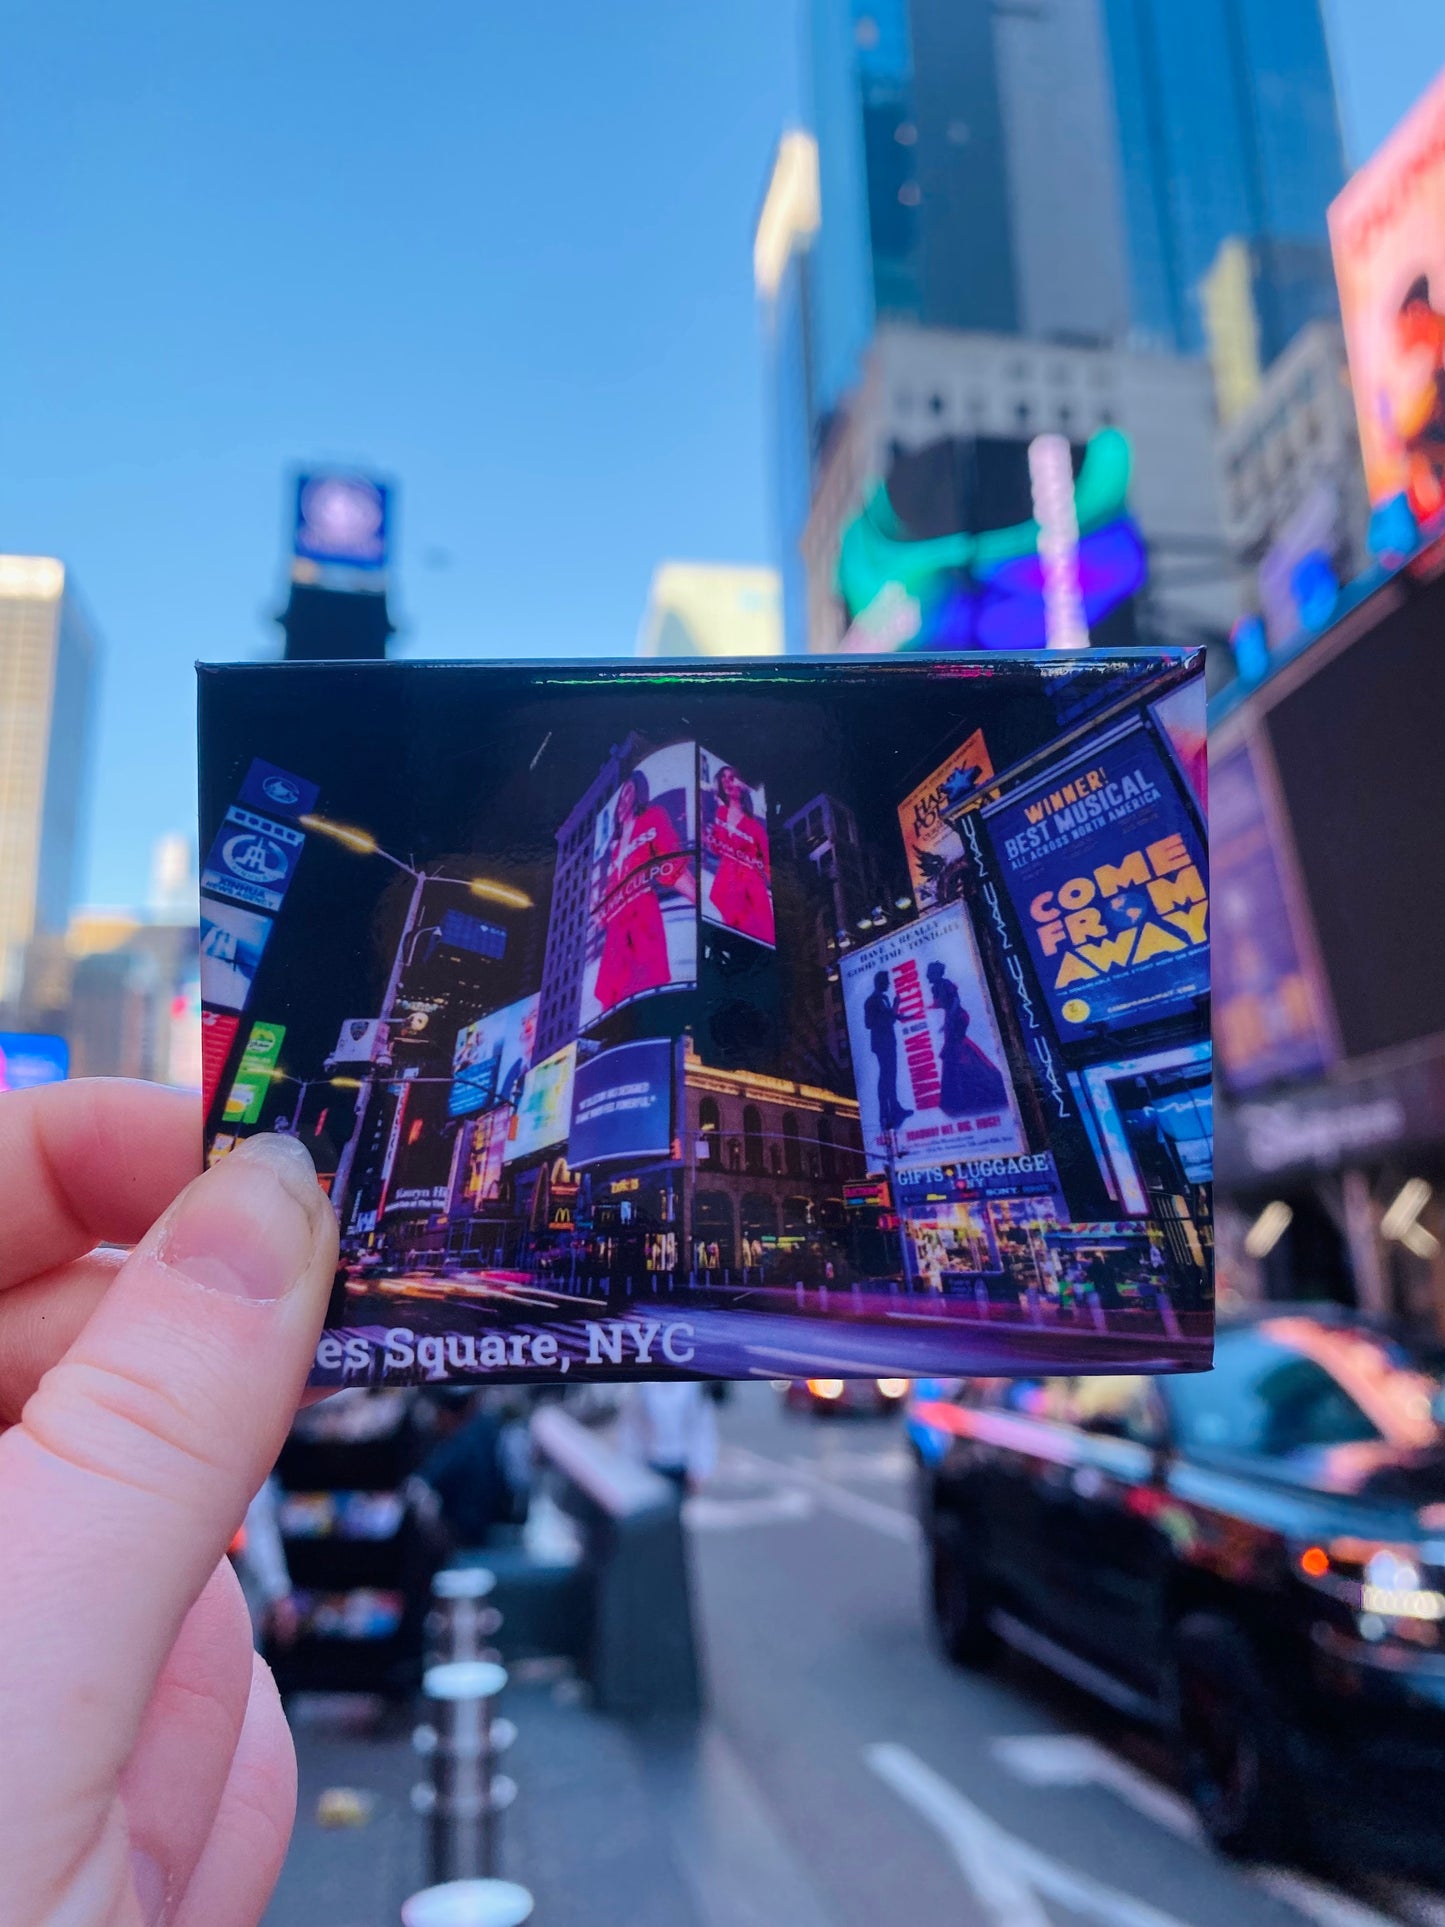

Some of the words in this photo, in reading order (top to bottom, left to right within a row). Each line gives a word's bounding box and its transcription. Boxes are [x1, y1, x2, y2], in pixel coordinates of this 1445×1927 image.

[1004, 820, 1050, 859] BEST
[1054, 769, 1155, 834] MUSICAL
[1011, 856, 1029, 871] ALL
[1031, 834, 1070, 861] ACROSS
[1071, 818, 1107, 840] NORTH
[1109, 788, 1162, 822] AMERICA
[1024, 767, 1109, 824] WINNER!
[625, 862, 674, 894] CULPO
[1030, 832, 1193, 923] COME
[1054, 899, 1209, 989] AWAY
[890, 959, 927, 1024] PRETTY
[904, 1030, 941, 1112] WOMAN
[898, 1167, 944, 1186] GIFTS
[957, 1153, 1049, 1180] LUGGAGE
[384, 1326, 573, 1379] Square,
[585, 1321, 696, 1366] NYC
